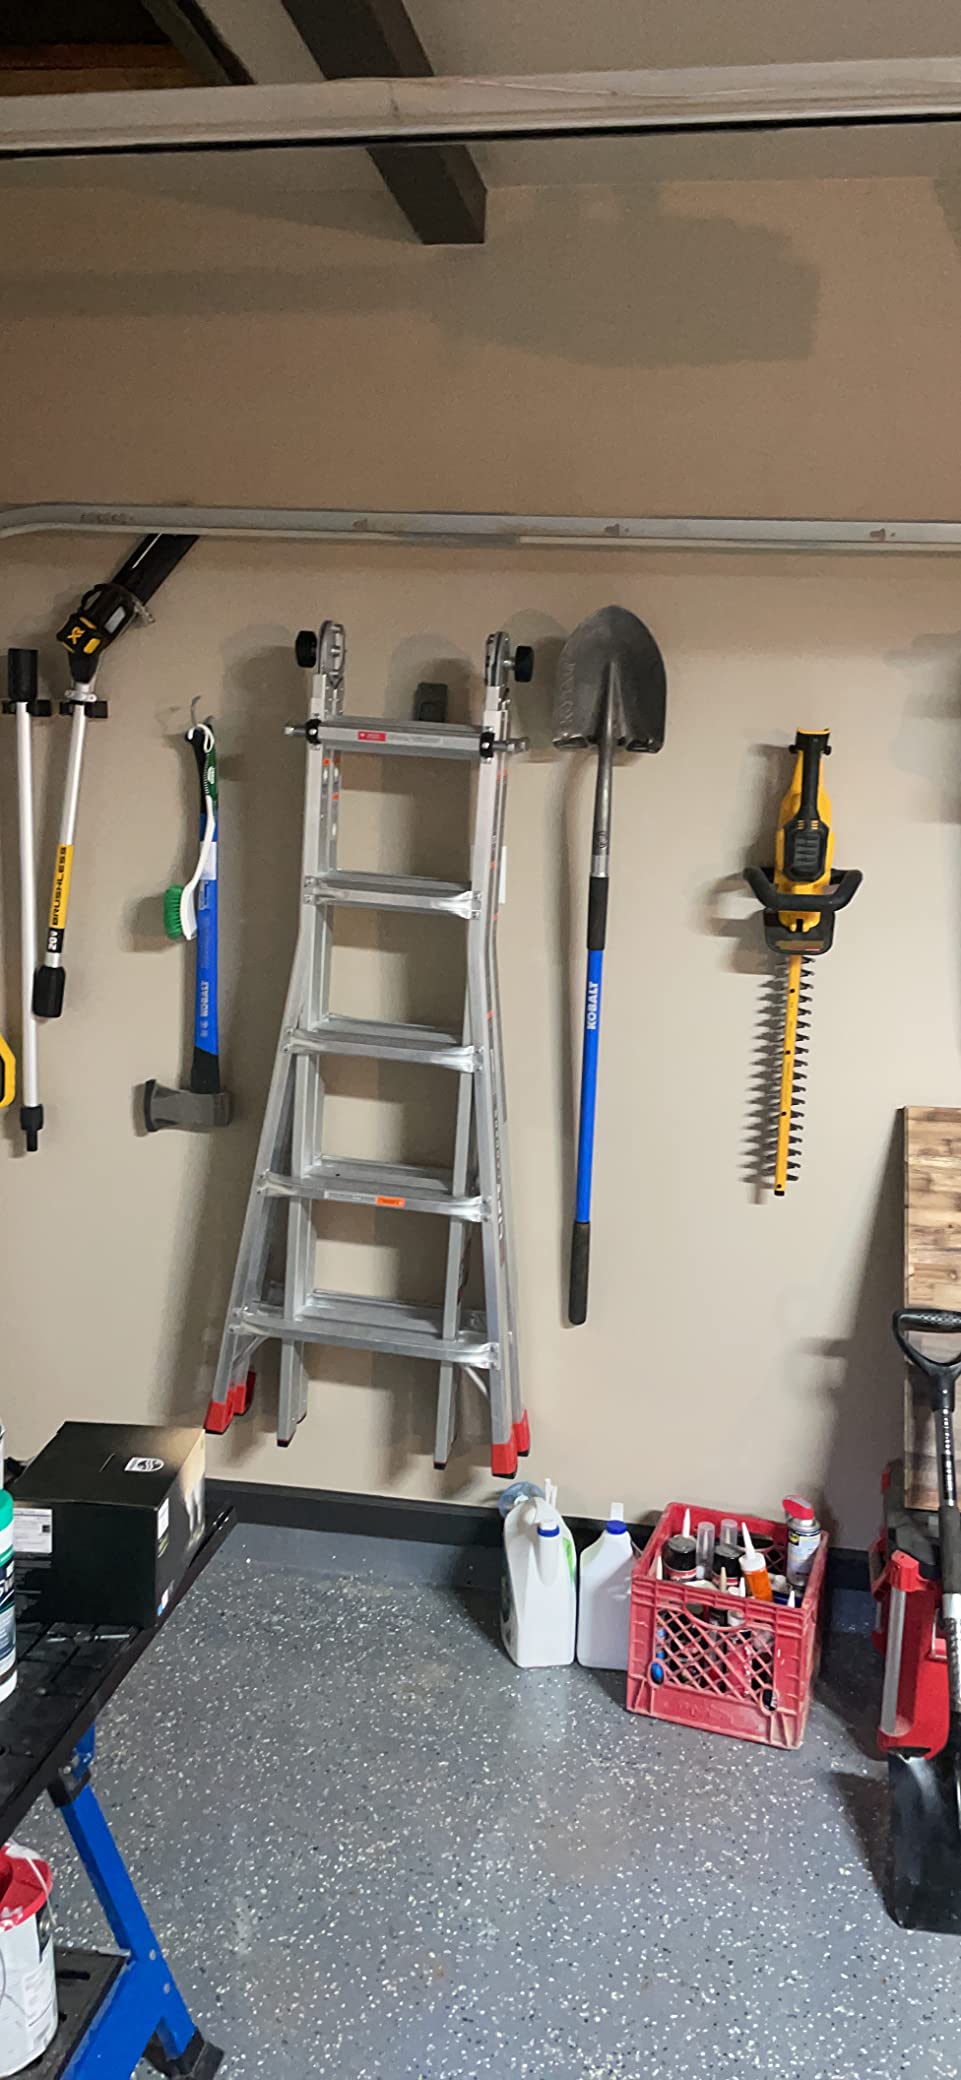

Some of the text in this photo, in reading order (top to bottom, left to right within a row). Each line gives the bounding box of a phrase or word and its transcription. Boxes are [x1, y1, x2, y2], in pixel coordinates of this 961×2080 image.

[67, 626, 86, 645] XR
[52, 847, 66, 926] BRUSHLESS
[586, 981, 599, 1030] KOBALT
